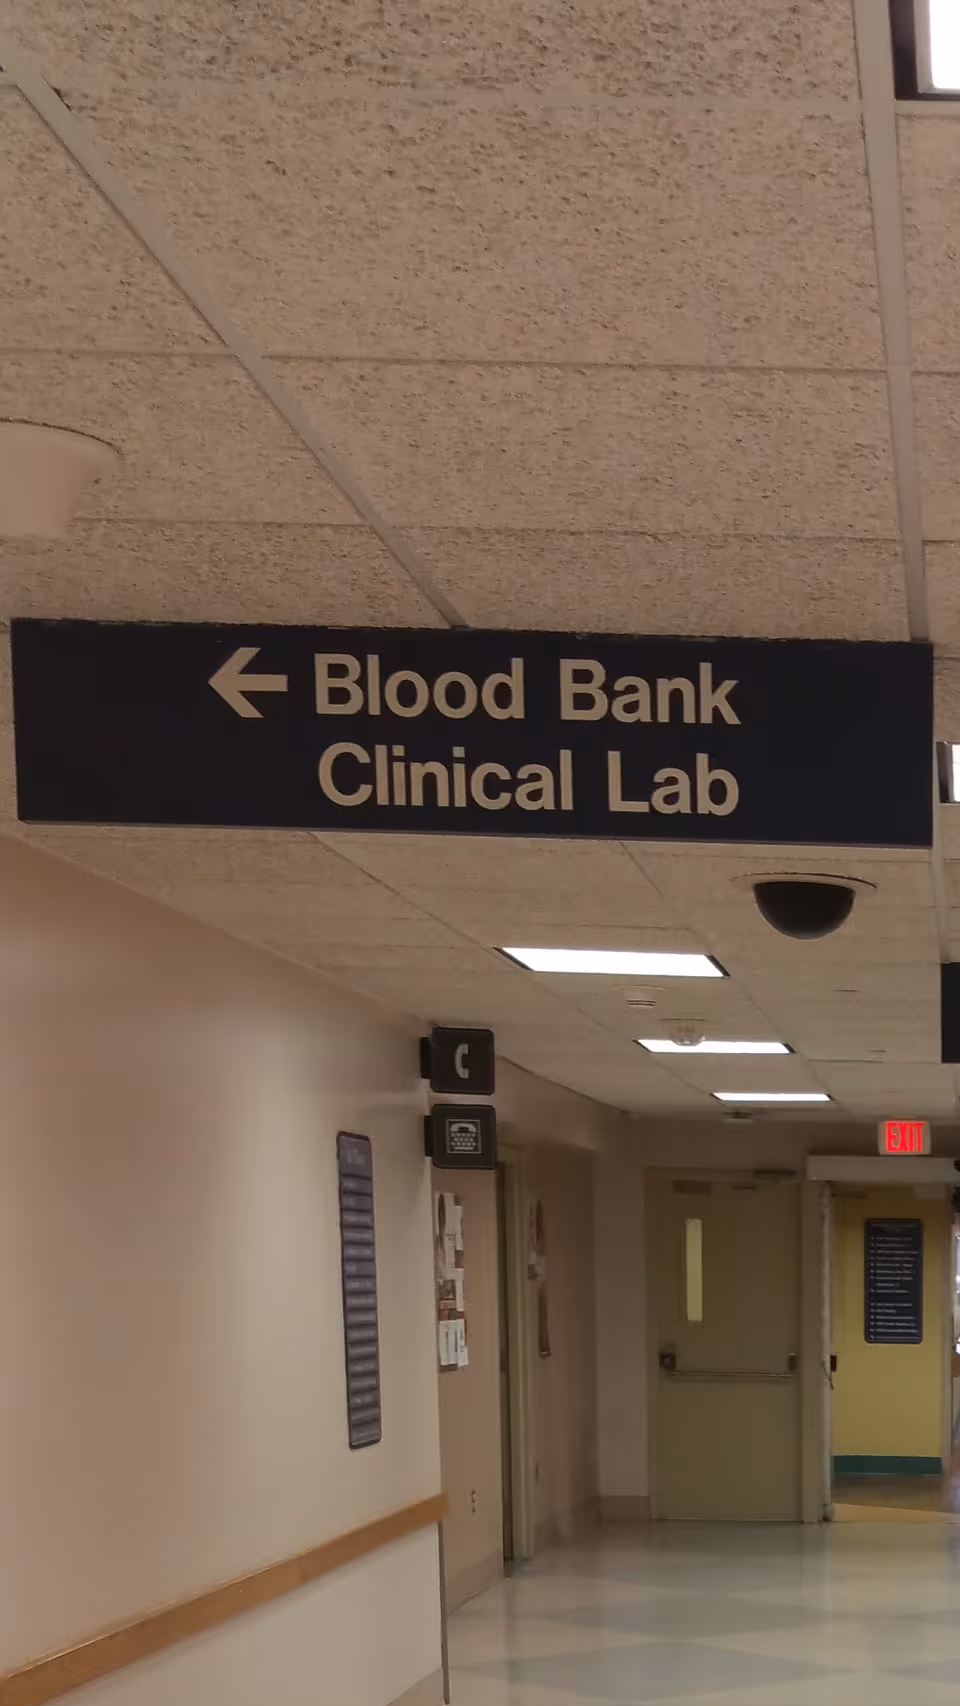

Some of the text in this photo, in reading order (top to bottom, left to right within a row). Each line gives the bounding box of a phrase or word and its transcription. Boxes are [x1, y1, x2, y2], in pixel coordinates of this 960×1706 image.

[314, 653, 742, 725] Blood Bank
[318, 741, 739, 816] Clinical Lab
[887, 1122, 923, 1152] EXIT
